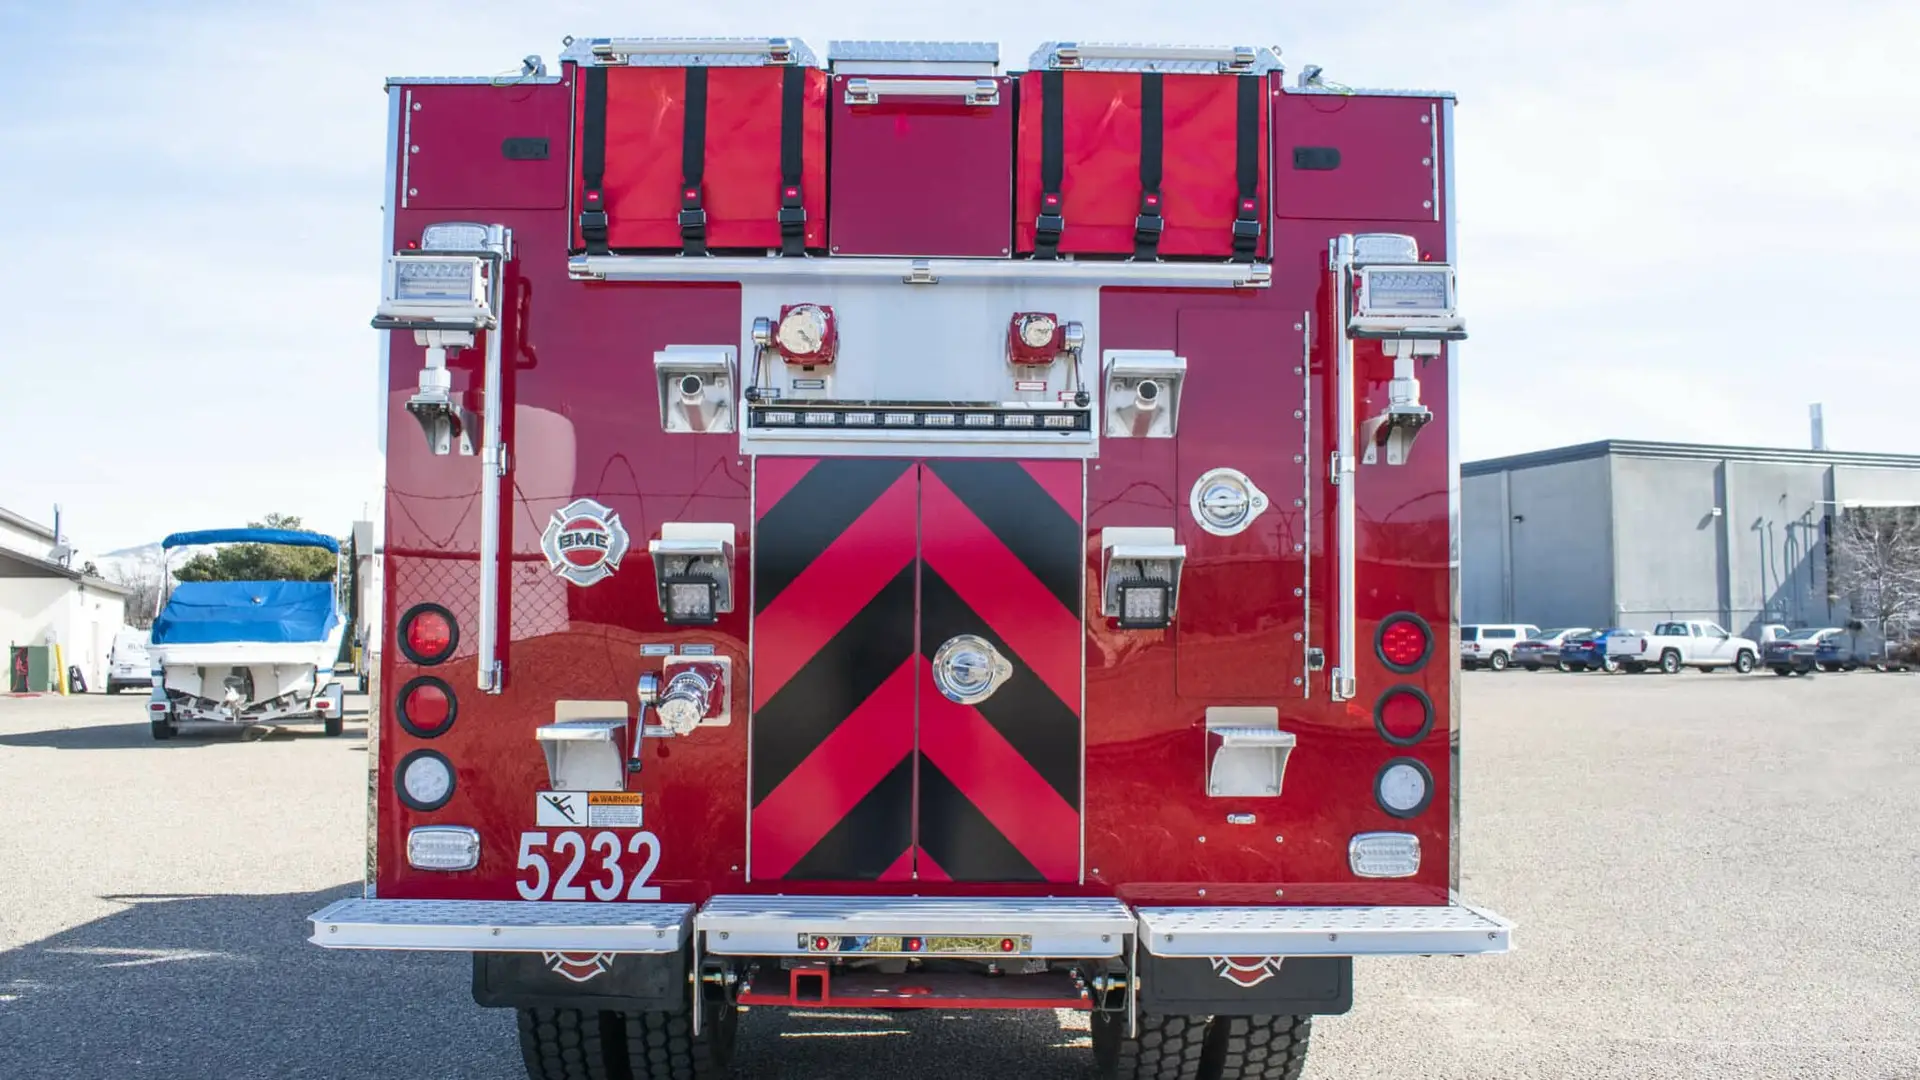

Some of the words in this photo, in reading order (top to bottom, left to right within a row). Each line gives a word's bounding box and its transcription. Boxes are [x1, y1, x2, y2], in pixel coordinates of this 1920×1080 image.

[558, 531, 609, 550] BME
[600, 795, 639, 804] WARNING
[515, 831, 661, 901] 5232
